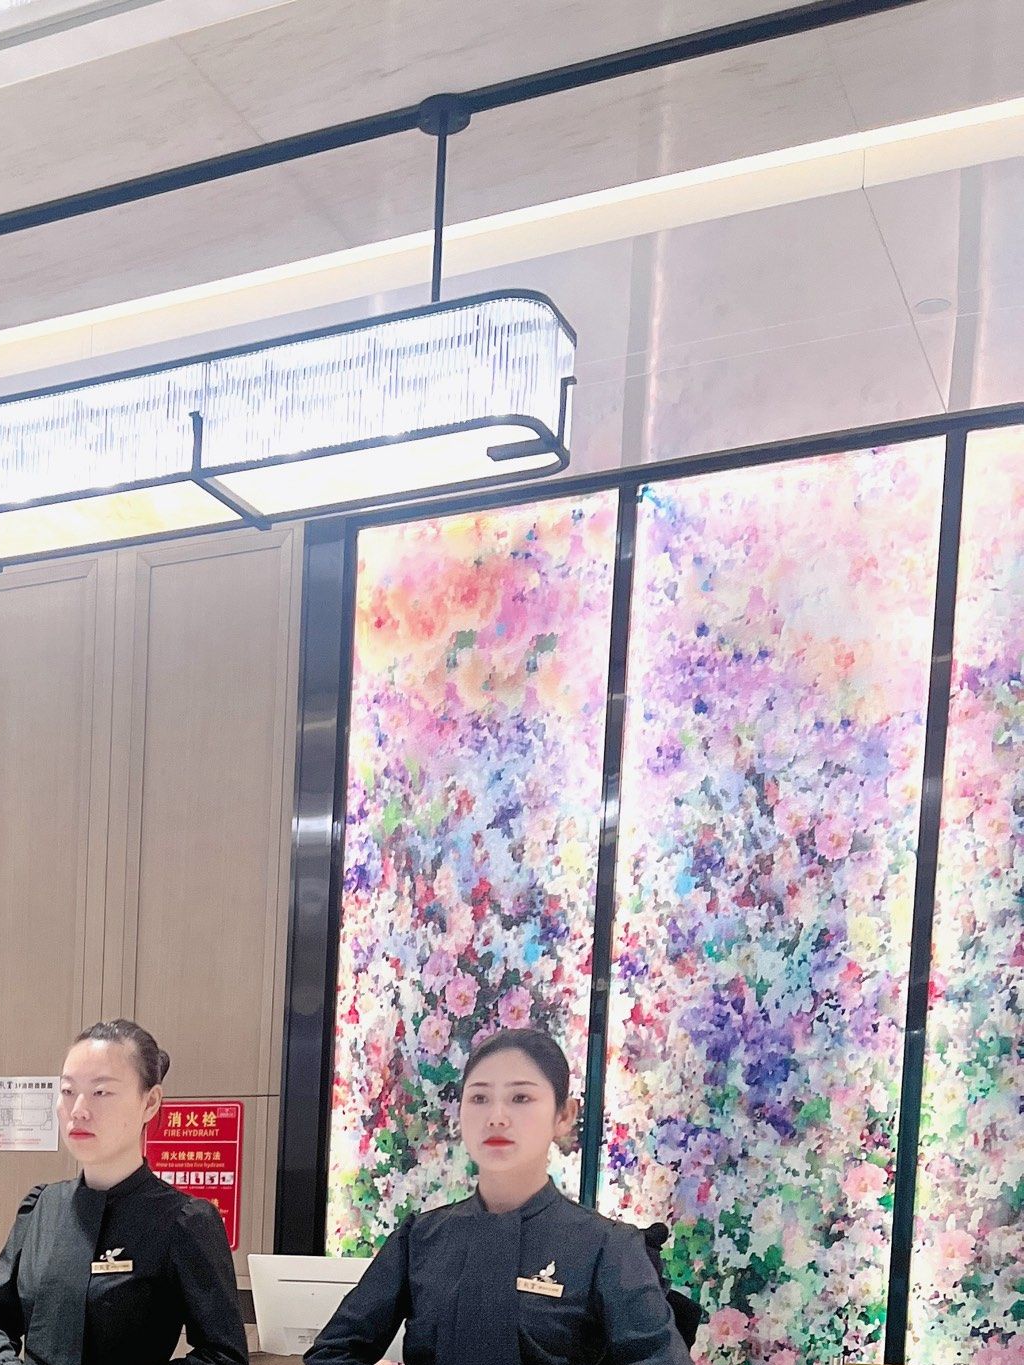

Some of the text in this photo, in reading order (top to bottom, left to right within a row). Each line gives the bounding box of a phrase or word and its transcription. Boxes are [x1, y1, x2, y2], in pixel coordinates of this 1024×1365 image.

[167, 1111, 217, 1127] 消火栓
[161, 1151, 221, 1160] 消火栓使用方法
